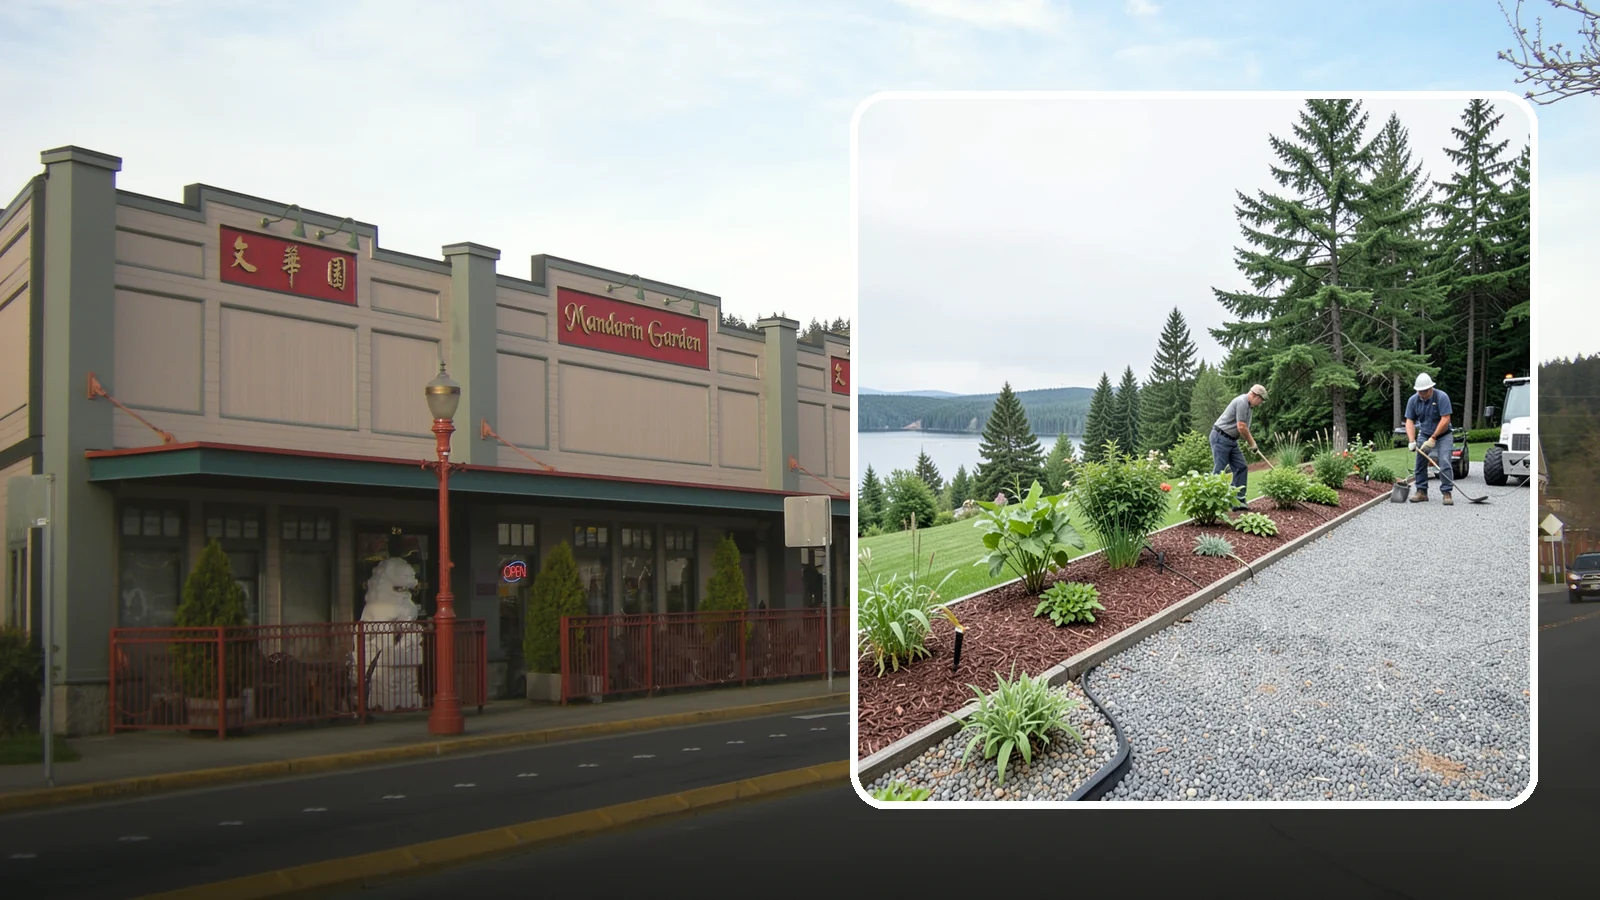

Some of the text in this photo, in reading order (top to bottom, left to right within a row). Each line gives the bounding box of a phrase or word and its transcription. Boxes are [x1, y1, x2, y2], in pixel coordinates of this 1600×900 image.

[230, 235, 346, 291] 文華園
[564, 302, 702, 352] Mandarin Garden
[503, 565, 527, 579] OPEN
